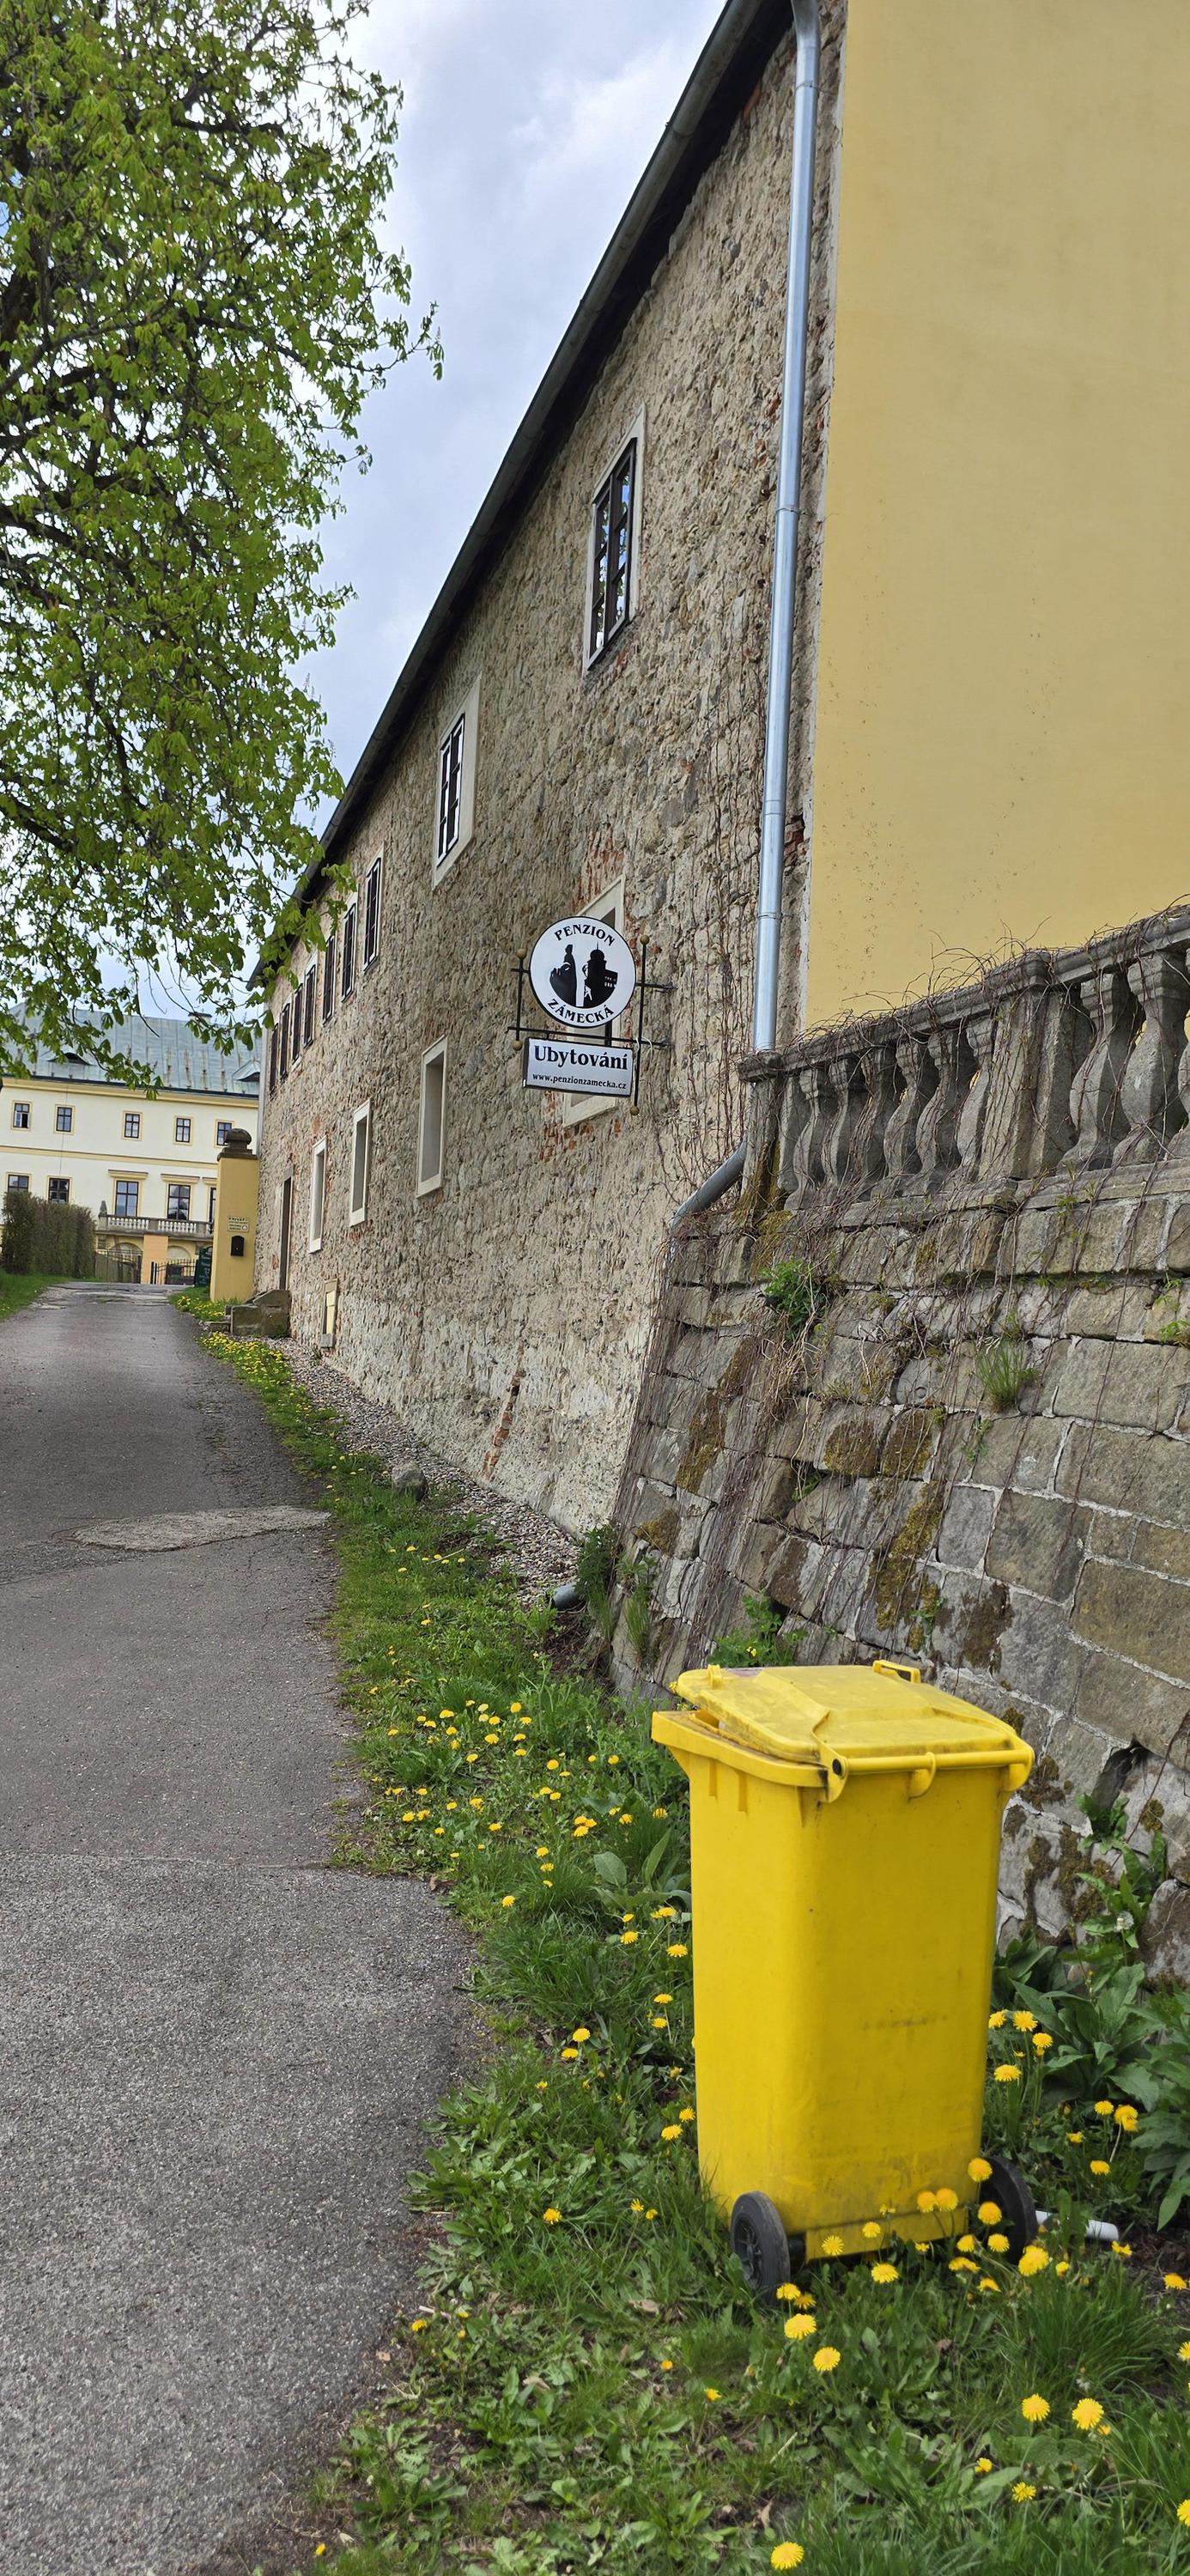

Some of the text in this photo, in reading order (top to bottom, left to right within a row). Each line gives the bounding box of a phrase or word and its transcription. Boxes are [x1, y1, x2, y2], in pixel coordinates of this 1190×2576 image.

[554, 925, 615, 946] PENZION
[547, 999, 615, 1024] ZÁMECKÁ
[534, 1045, 628, 1070] Ubytování
[532, 1072, 627, 1090] www.penzionzamecka.cz
